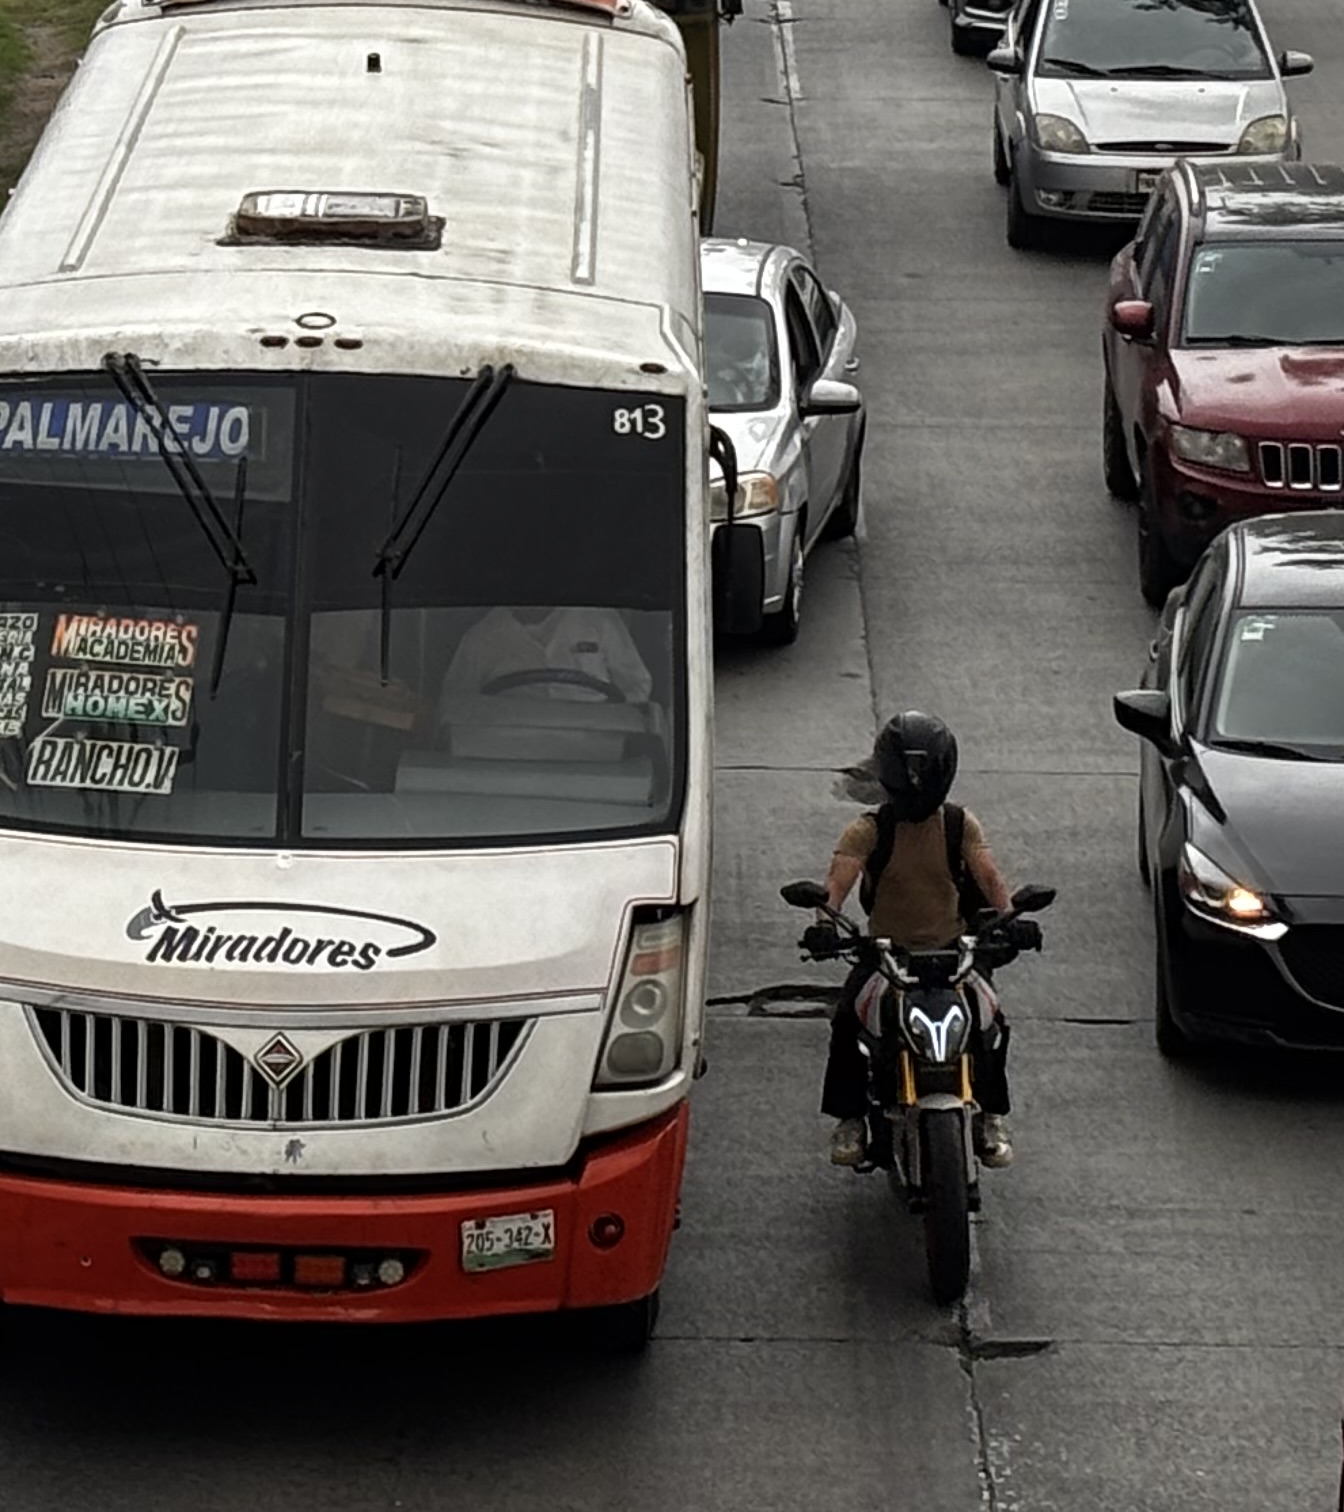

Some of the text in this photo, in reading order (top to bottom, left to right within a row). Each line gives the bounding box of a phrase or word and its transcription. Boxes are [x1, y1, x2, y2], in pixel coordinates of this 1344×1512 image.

[613, 403, 666, 440] 813
[51, 614, 198, 667] MIRADORES
[75, 637, 179, 666] ACADEMIA
[46, 670, 192, 723] MIRADORES
[64, 693, 171, 722] HOMEX
[145, 925, 383, 971] Miradores
